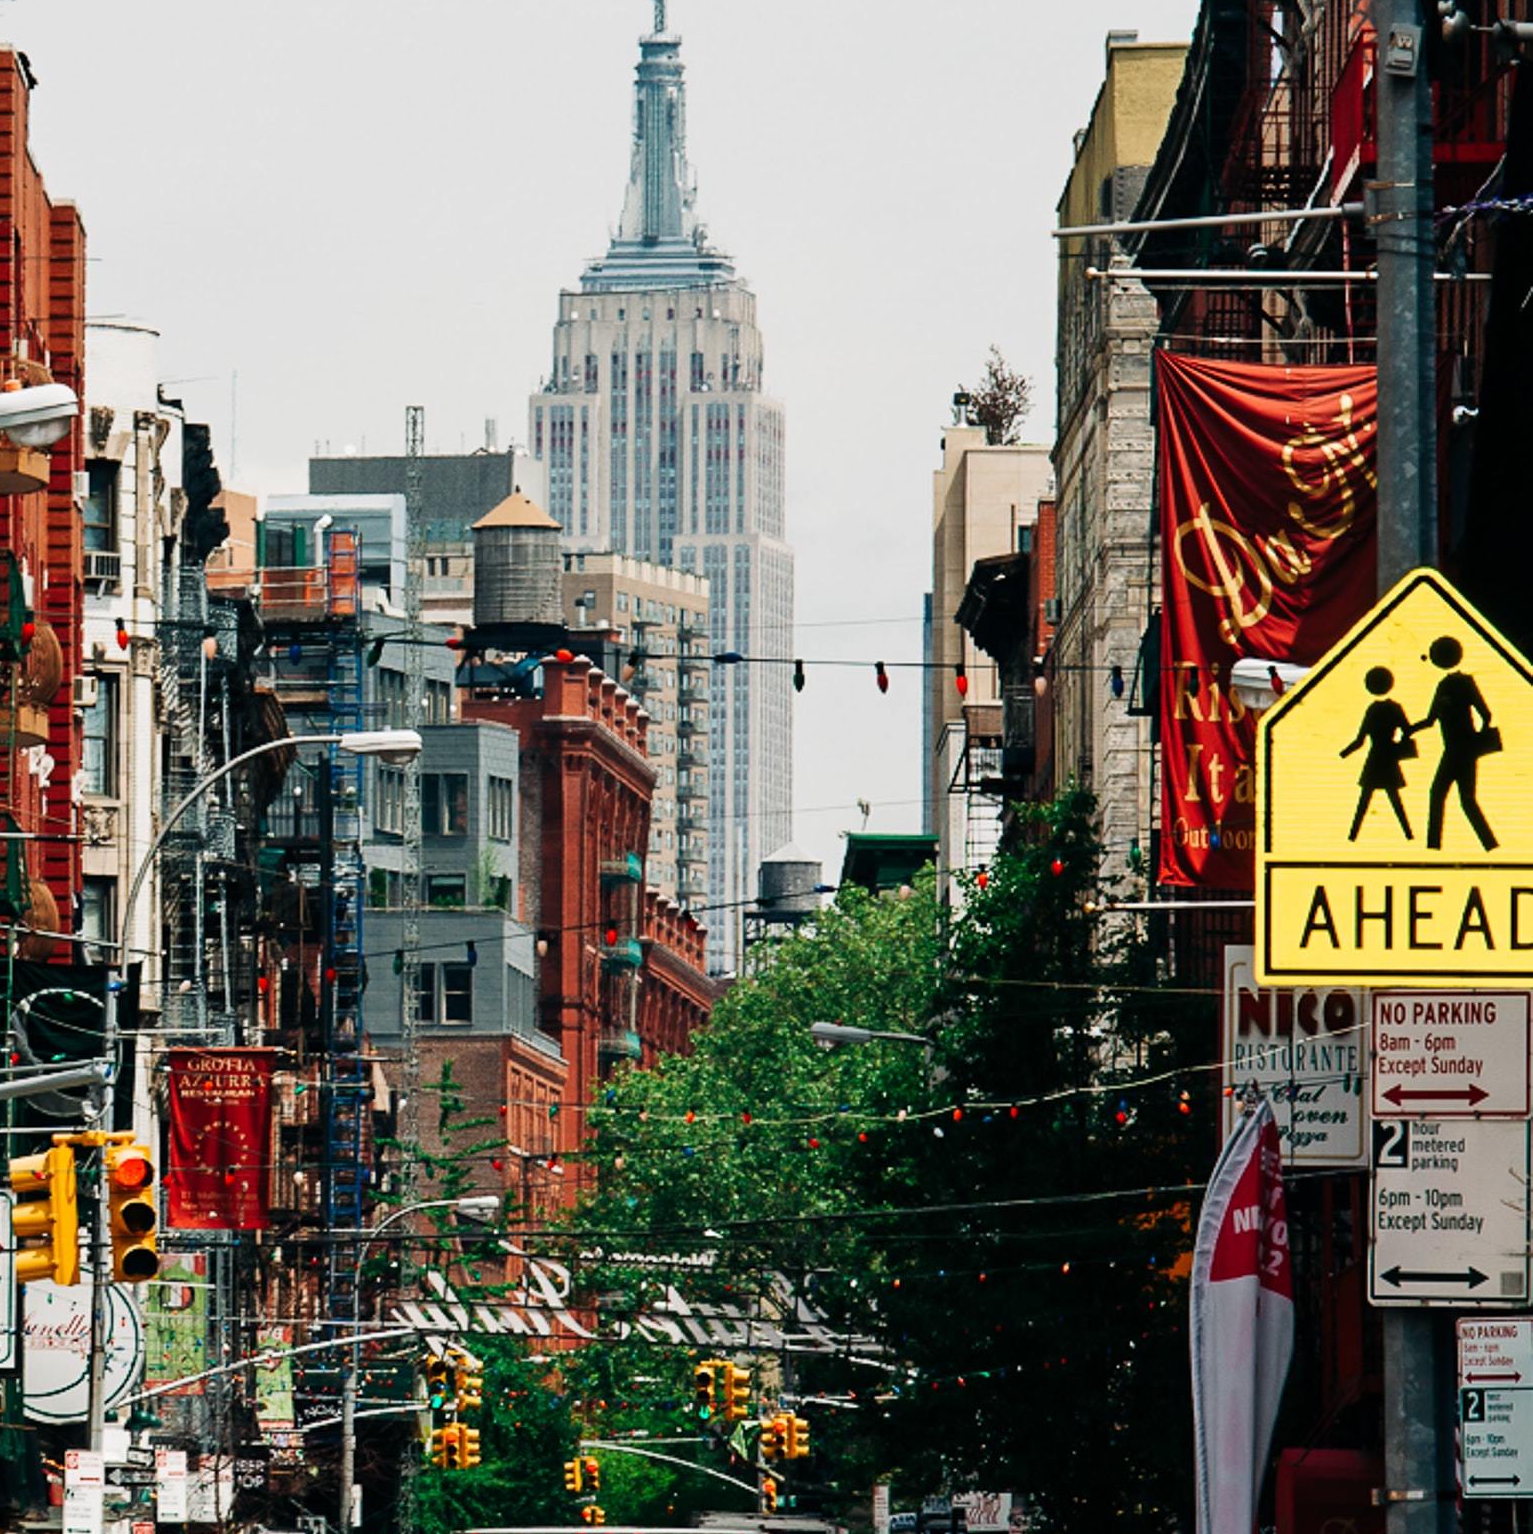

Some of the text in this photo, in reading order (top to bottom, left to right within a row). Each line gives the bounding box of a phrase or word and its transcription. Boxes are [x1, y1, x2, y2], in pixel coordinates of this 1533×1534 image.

[1299, 885, 1533, 950] AHEAD
[1238, 987, 1355, 1037] NICO
[1380, 1002, 1496, 1025] NO PARKING
[1379, 1033, 1410, 1051] 8am
[1424, 1034, 1456, 1053] 6pm
[1235, 1044, 1357, 1072] RISTORANTE
[1379, 1057, 1483, 1077] Except Sunday
[1271, 1083, 1326, 1103] Cal
[1378, 1122, 1441, 1164] 2 hour
[1411, 1138, 1465, 1153] metered
[1411, 1156, 1458, 1173] parking
[1379, 1189, 1410, 1207] 6pm
[1425, 1189, 1462, 1208] 10pm
[1379, 1212, 1484, 1234] Except Sunday
[1463, 1326, 1518, 1339] NO PARKING
[1468, 1392, 1479, 1419] 2
